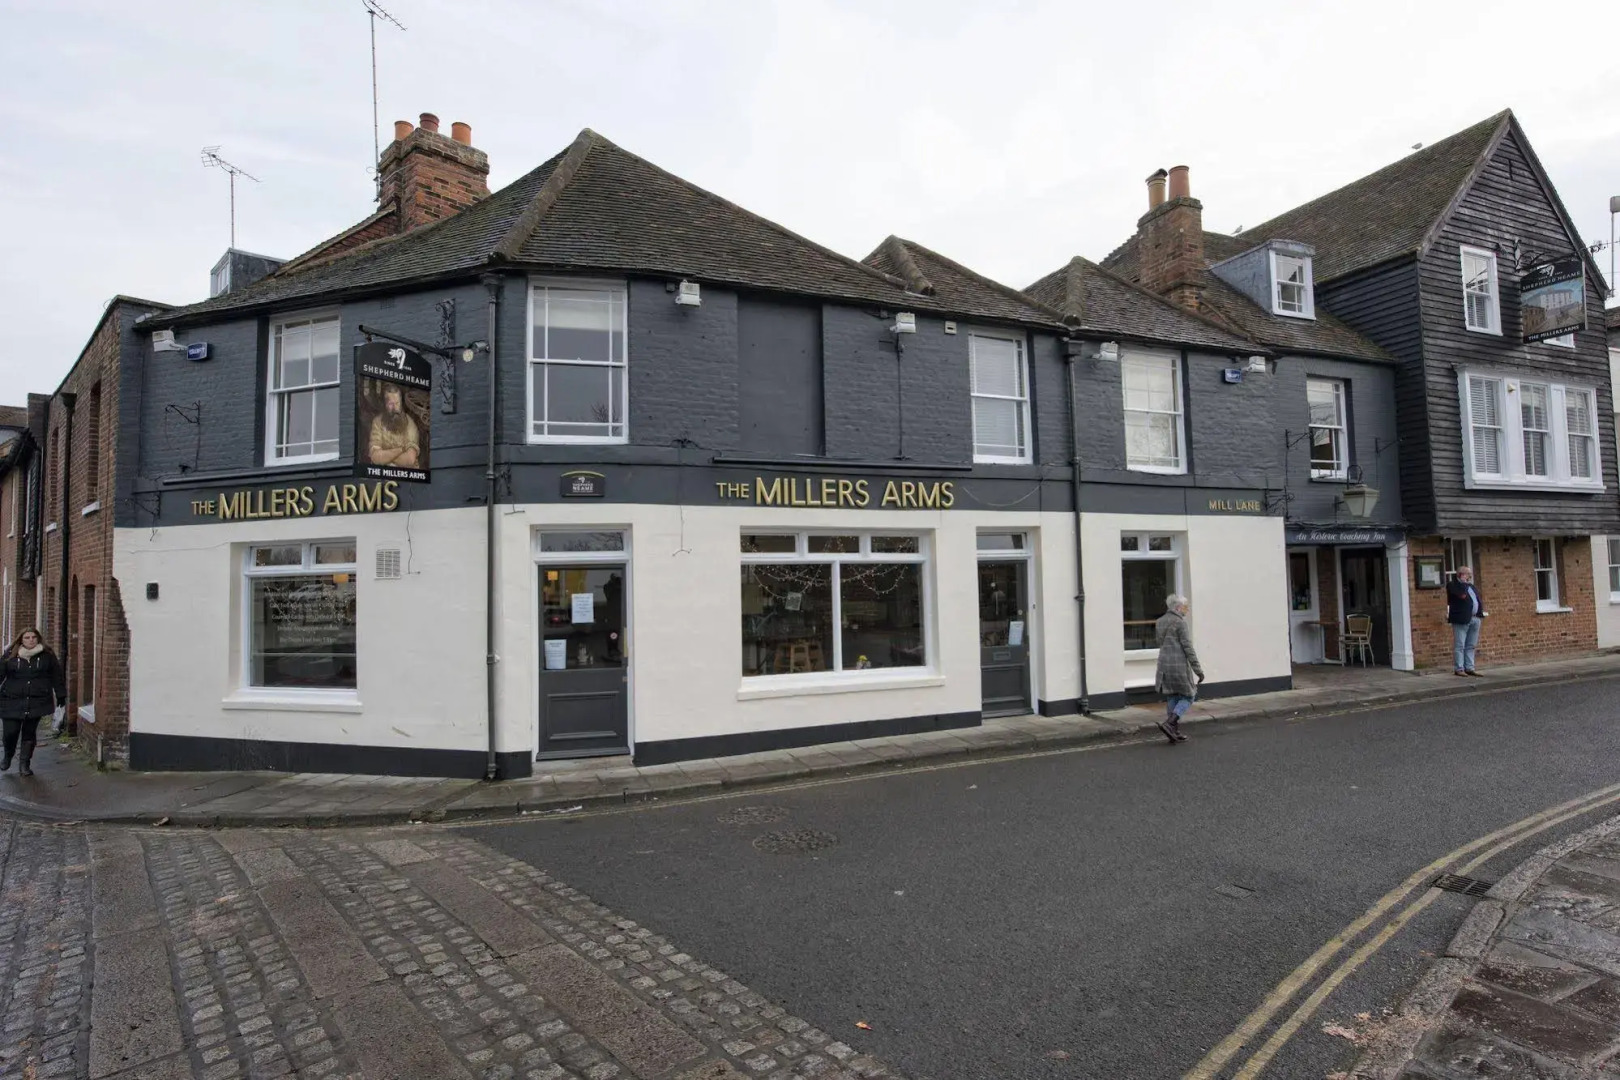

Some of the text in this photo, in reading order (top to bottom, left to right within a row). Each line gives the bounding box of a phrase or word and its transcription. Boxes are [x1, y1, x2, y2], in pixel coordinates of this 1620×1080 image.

[1540, 329, 1563, 338] MILLERS
[1563, 325, 1580, 333] ARMS
[363, 364, 405, 380] SHEPHERD
[405, 374, 430, 387] NEAME
[367, 467, 426, 480] THE MILLERS ARMS
[191, 480, 399, 520] THE MILLERS ARMS
[716, 476, 955, 508] THE MILLERS ARMS
[1208, 499, 1261, 511] MILL LANE
